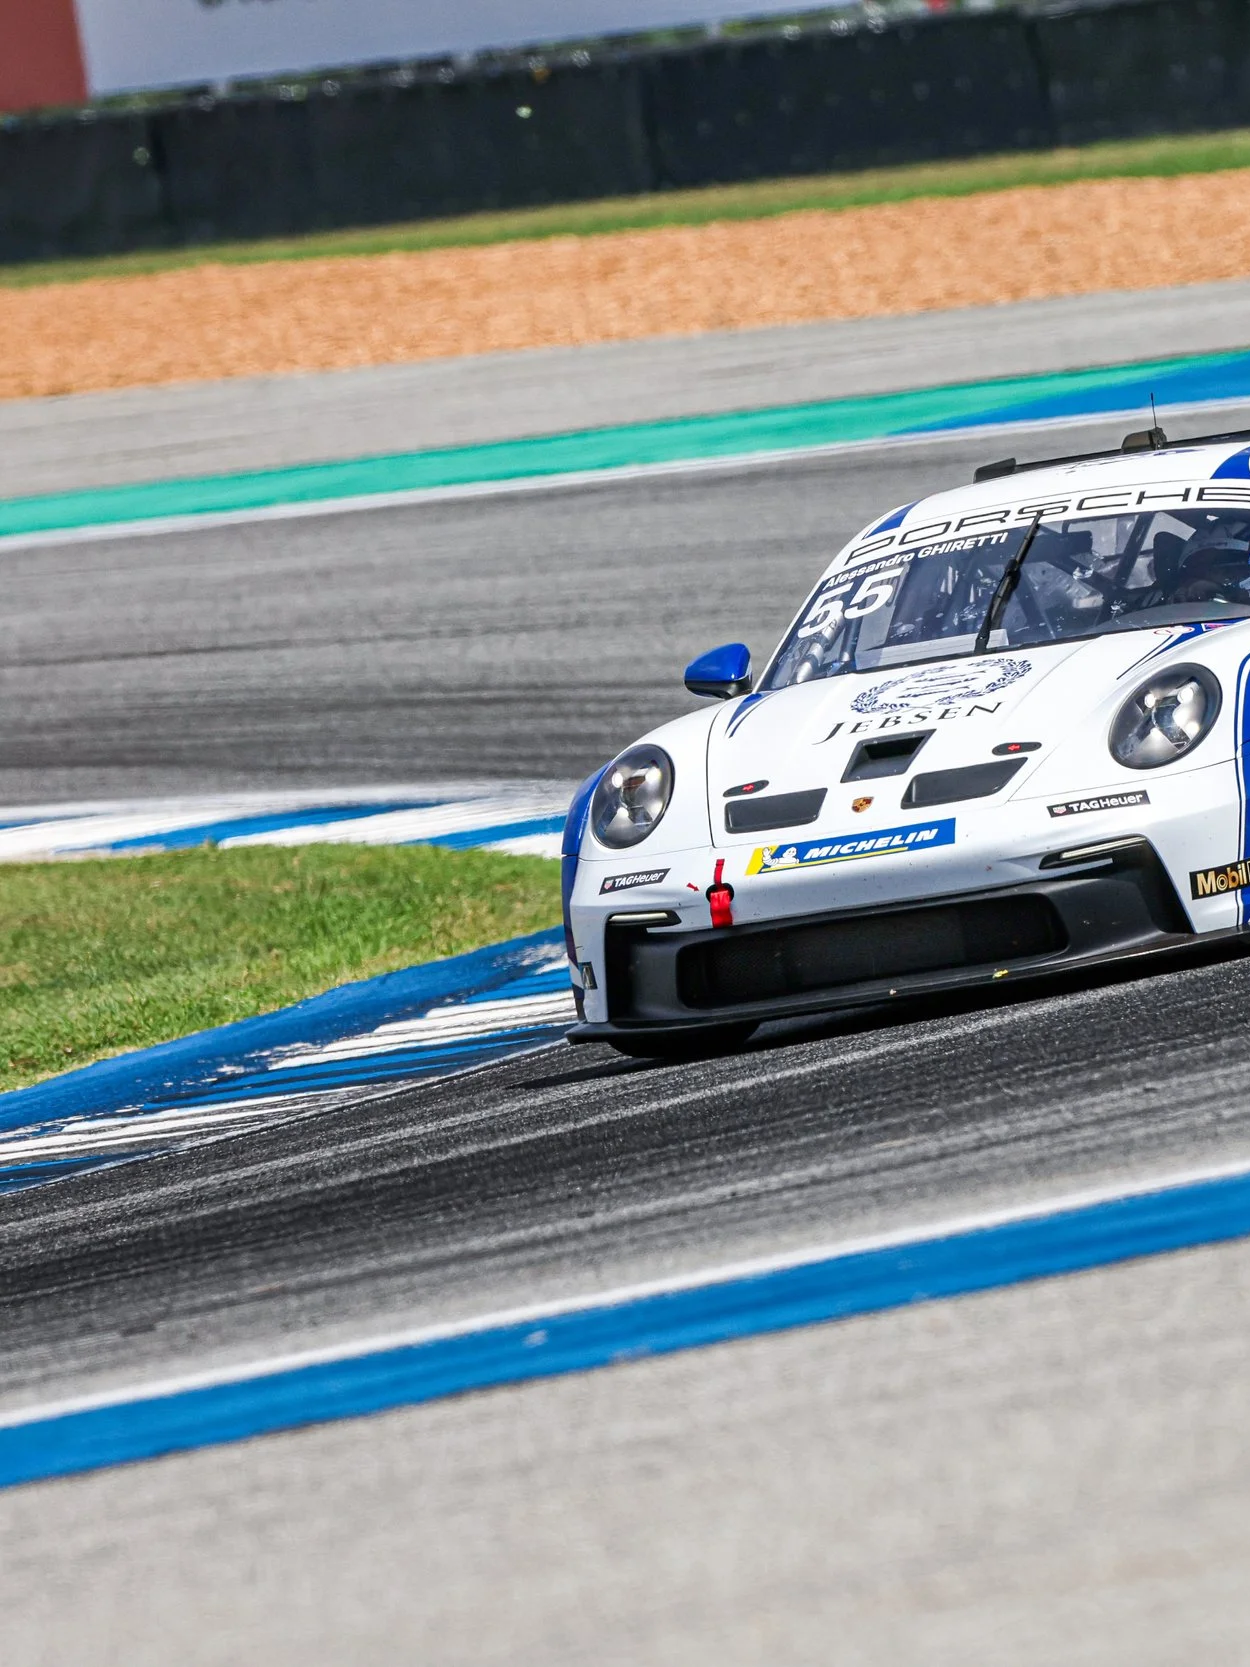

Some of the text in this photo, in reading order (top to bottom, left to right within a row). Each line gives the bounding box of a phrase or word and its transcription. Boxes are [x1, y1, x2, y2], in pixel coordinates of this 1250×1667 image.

[823, 532, 1009, 591] Alessandro GHIRETTI
[797, 567, 904, 639] 55
[812, 702, 1005, 745] JEBSEN
[803, 828, 939, 860] MICHELIN
[1196, 862, 1248, 896] Mobil
